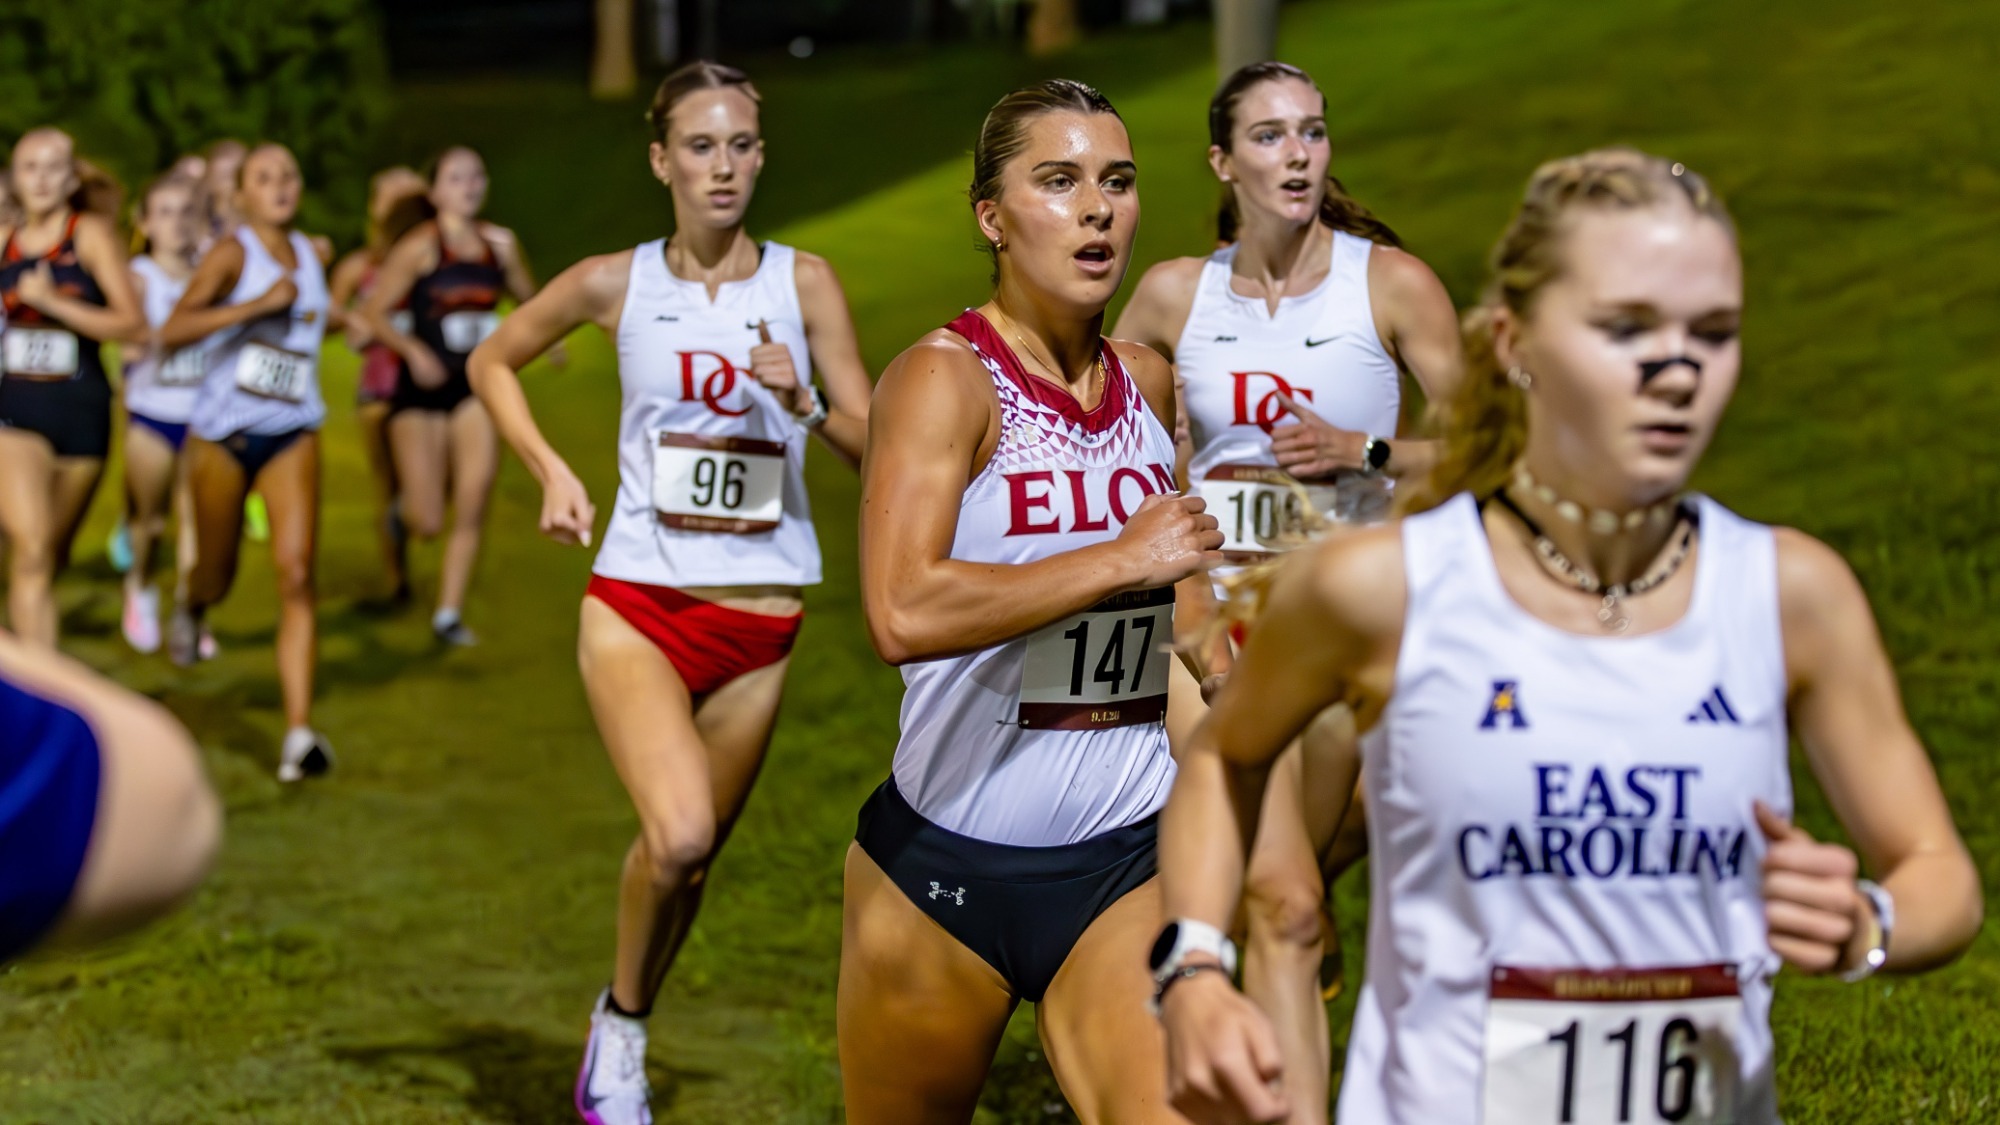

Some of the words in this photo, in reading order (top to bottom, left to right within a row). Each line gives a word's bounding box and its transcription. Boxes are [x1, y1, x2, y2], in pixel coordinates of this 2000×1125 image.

[691, 457, 747, 510] 96
[1064, 615, 1156, 696] 147
[1532, 763, 1701, 820] EAST
[1548, 1017, 1699, 1123] 116
